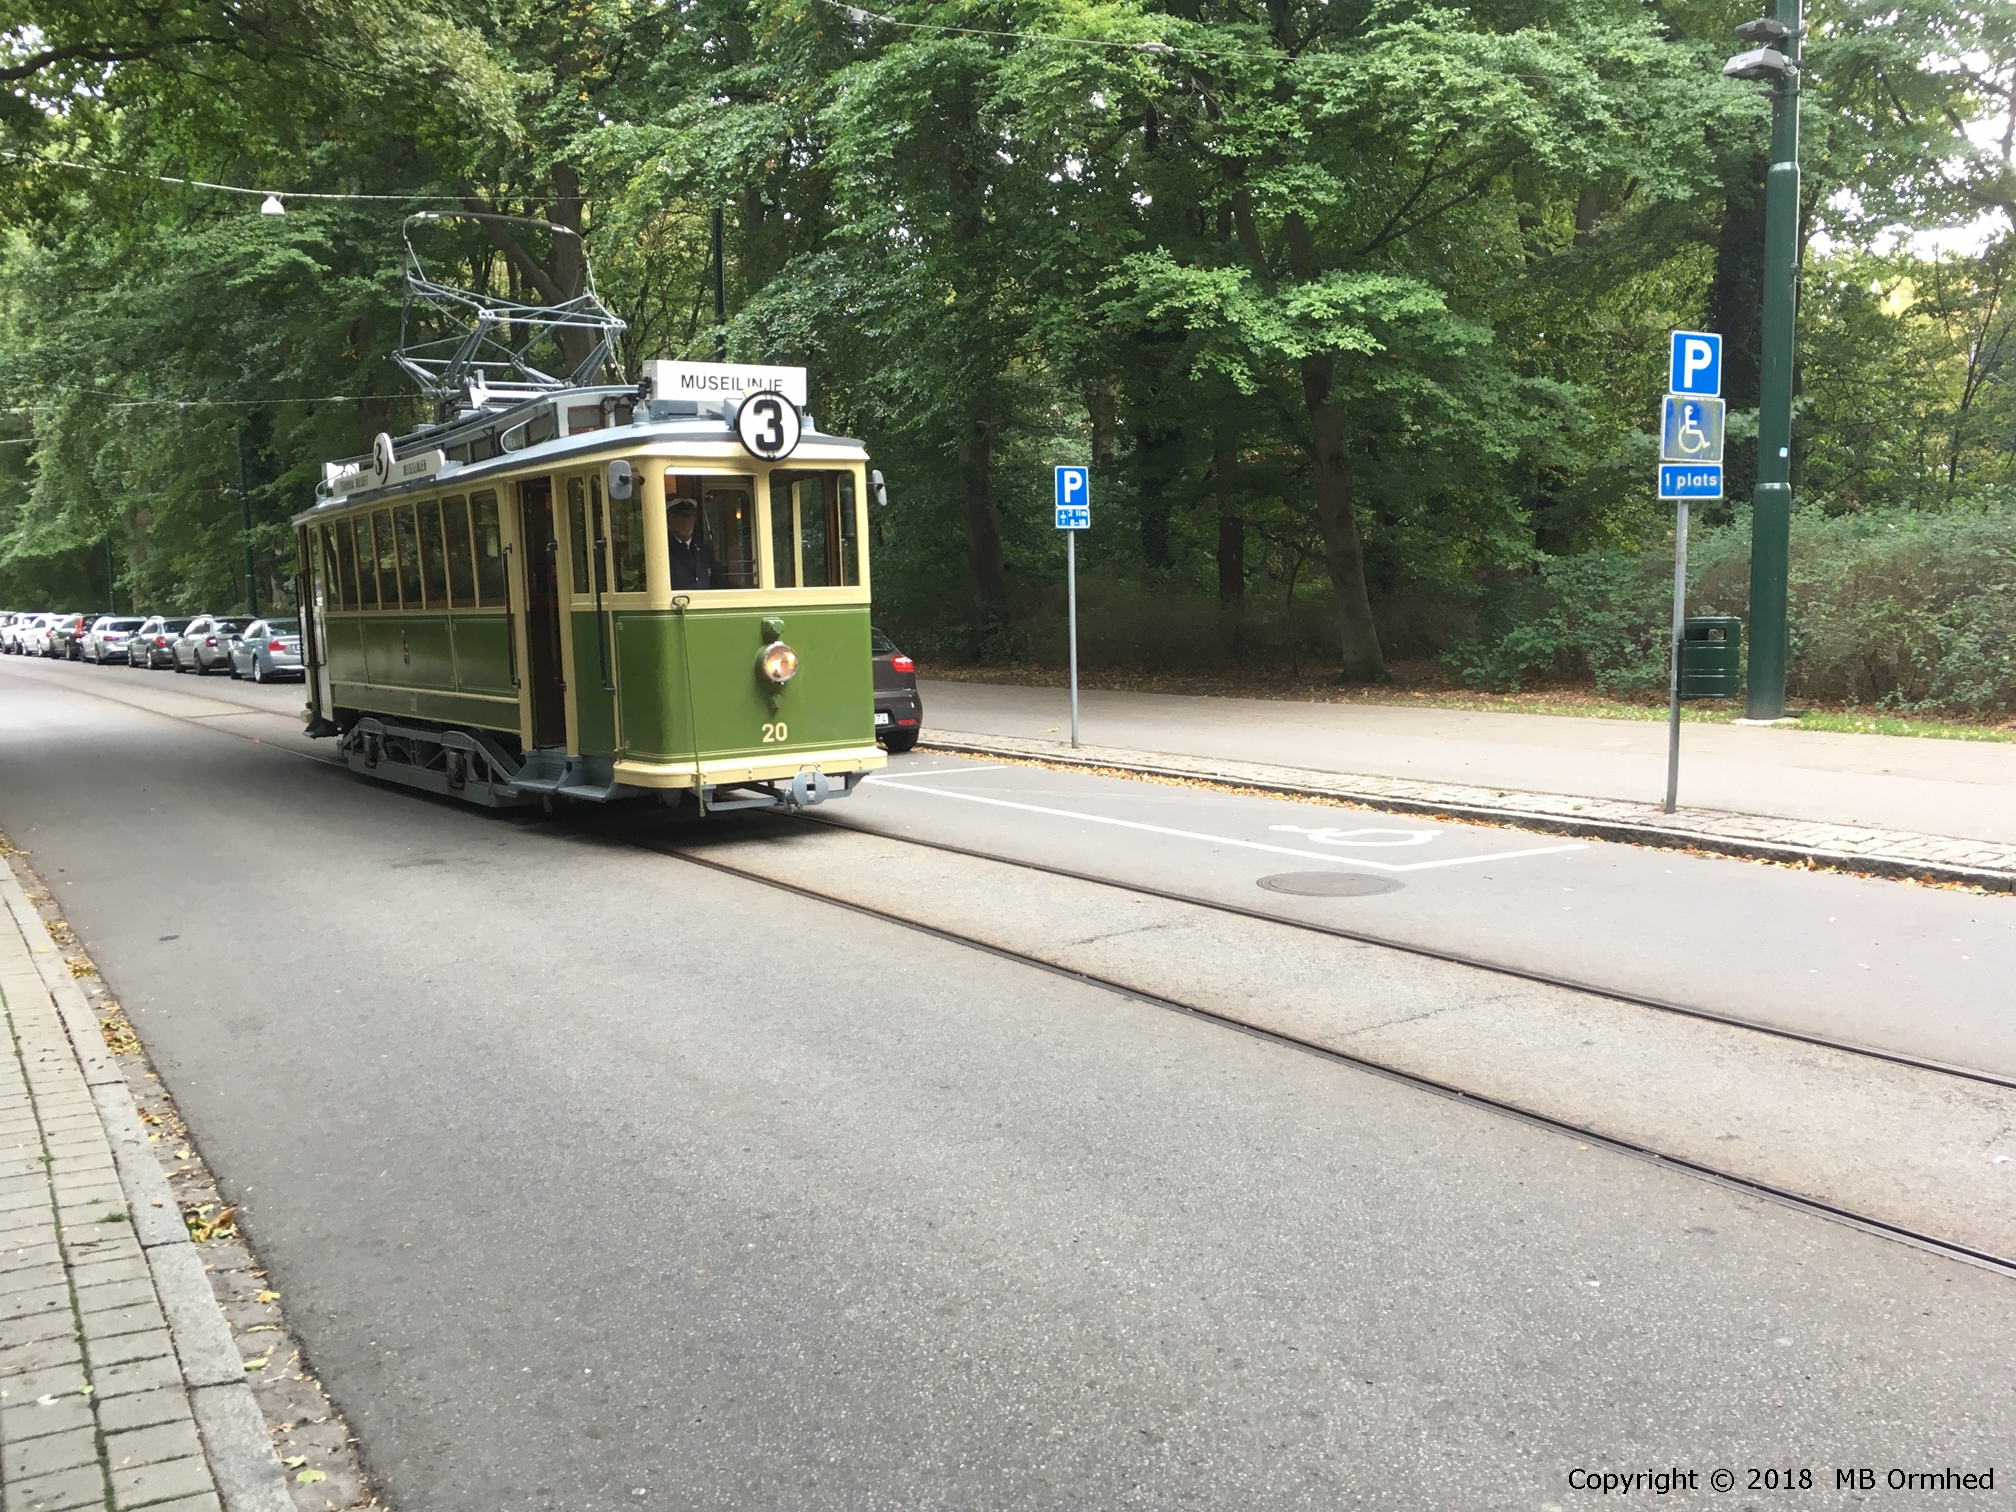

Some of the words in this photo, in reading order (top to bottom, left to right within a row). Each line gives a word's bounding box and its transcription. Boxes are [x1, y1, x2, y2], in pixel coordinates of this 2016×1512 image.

[1683, 338, 1713, 390] P
[681, 374, 783, 394] MUSEILINJE
[753, 399, 785, 451] 3
[375, 442, 384, 476] 3
[1063, 470, 1083, 503] P
[1665, 472, 1671, 487] 1
[1677, 472, 1718, 490] plats
[761, 721, 788, 743] 20
